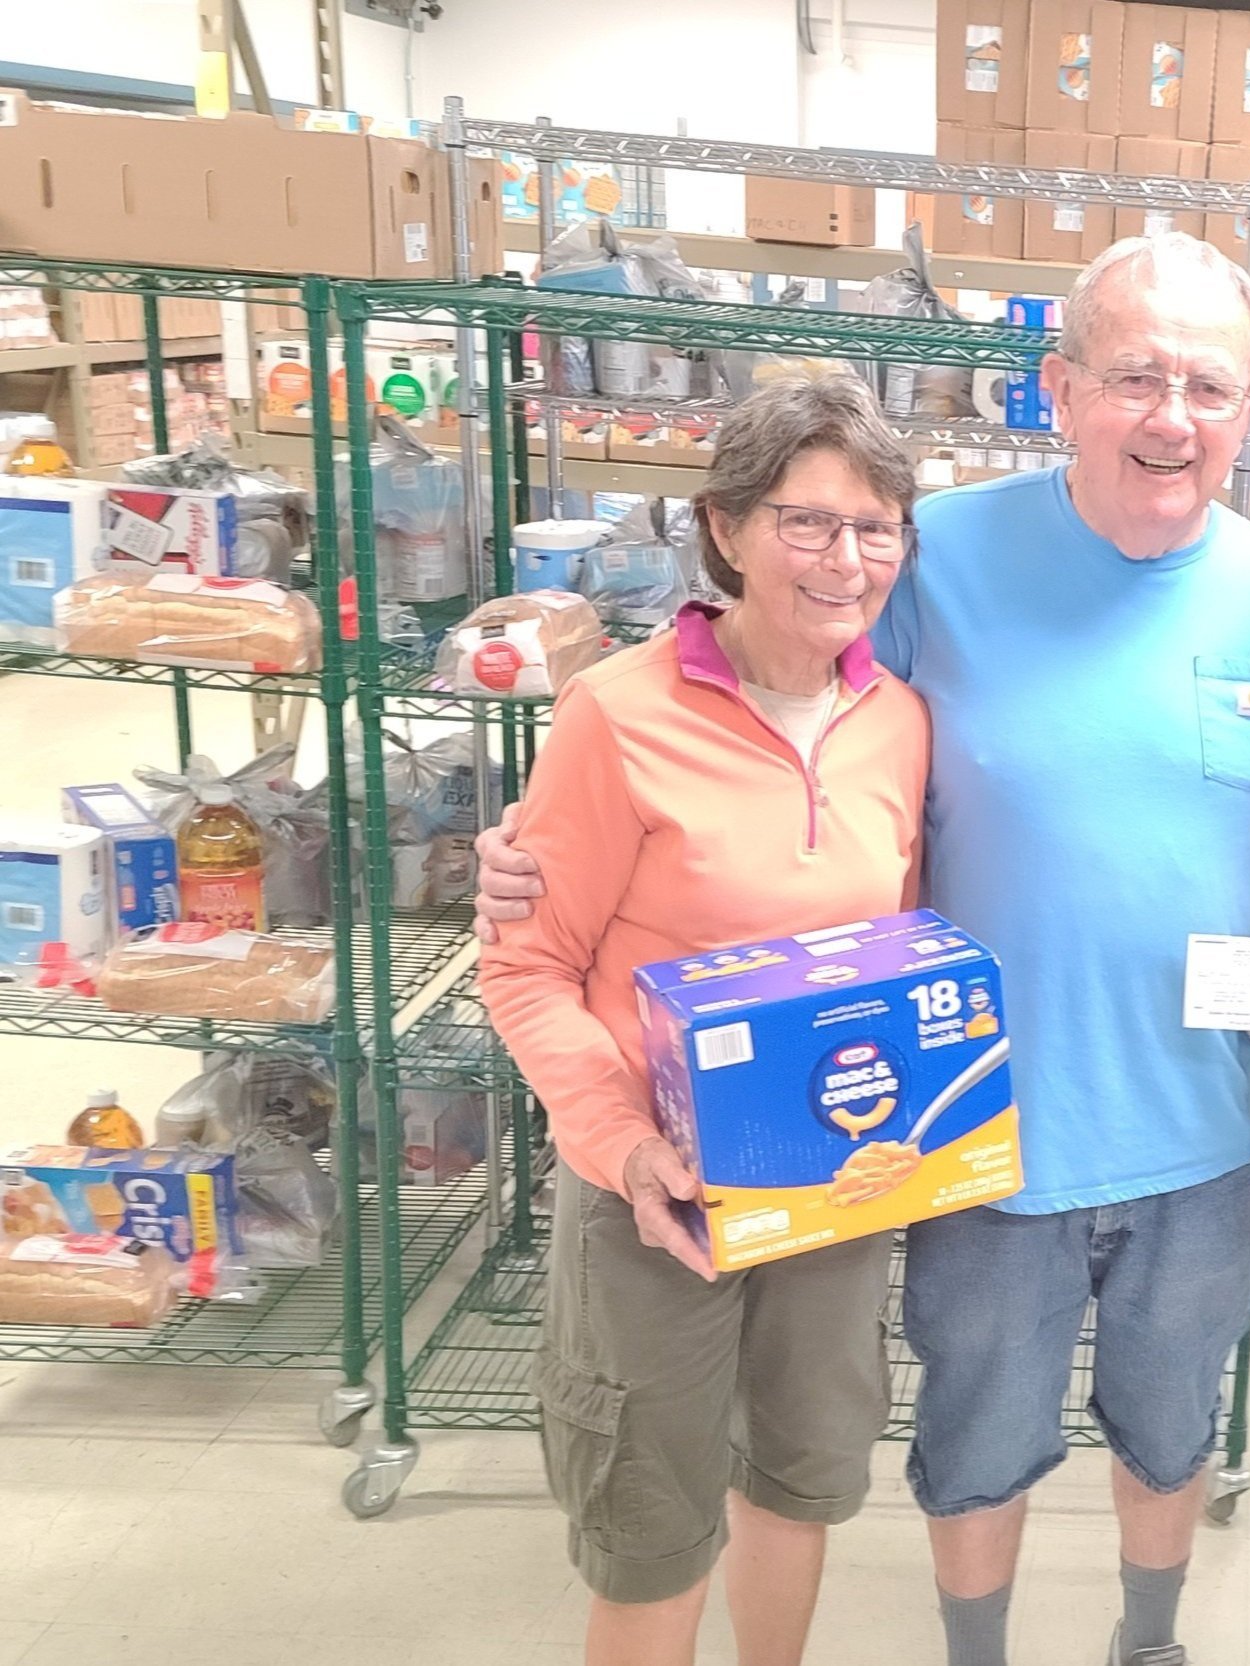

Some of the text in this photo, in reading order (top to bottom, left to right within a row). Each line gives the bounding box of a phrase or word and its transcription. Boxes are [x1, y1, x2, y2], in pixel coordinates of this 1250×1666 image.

[907, 980, 962, 1020] 18
[820, 1077, 898, 1106] cheese
[197, 1190, 210, 1243] FAMILY
